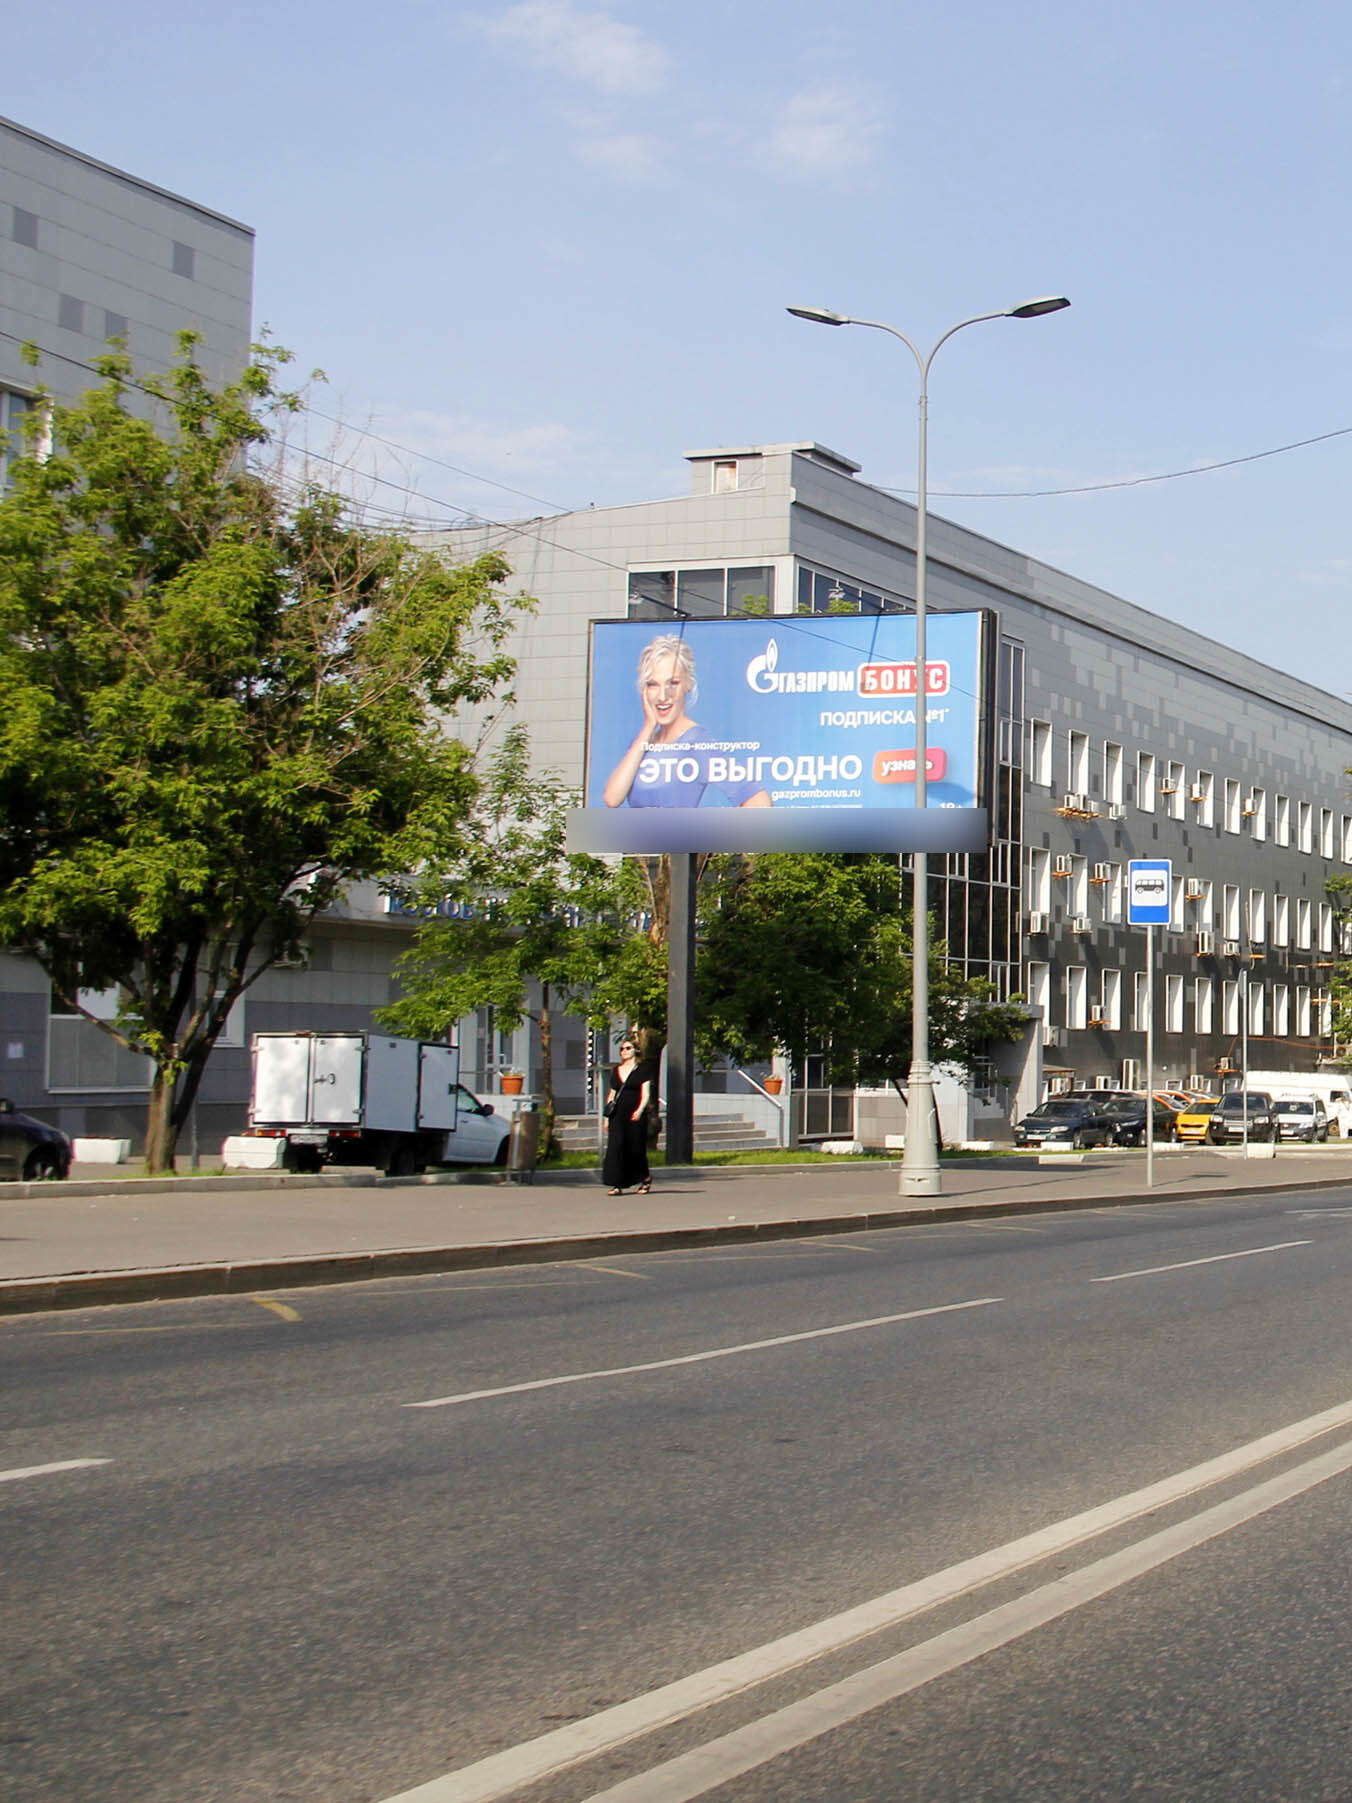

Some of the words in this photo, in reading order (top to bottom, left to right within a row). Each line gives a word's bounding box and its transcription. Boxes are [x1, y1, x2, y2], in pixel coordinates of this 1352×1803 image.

[778, 670, 855, 693] ГАЗПРОМ
[820, 710, 916, 728] ПОДПИСКА
[640, 741, 761, 753] Подписка-конструктор
[639, 757, 700, 783] ЭТО
[707, 754, 864, 787] ВЫГОДНО
[881, 758, 934, 777] узнаь
[771, 788, 861, 802] gazprombonus.ru
